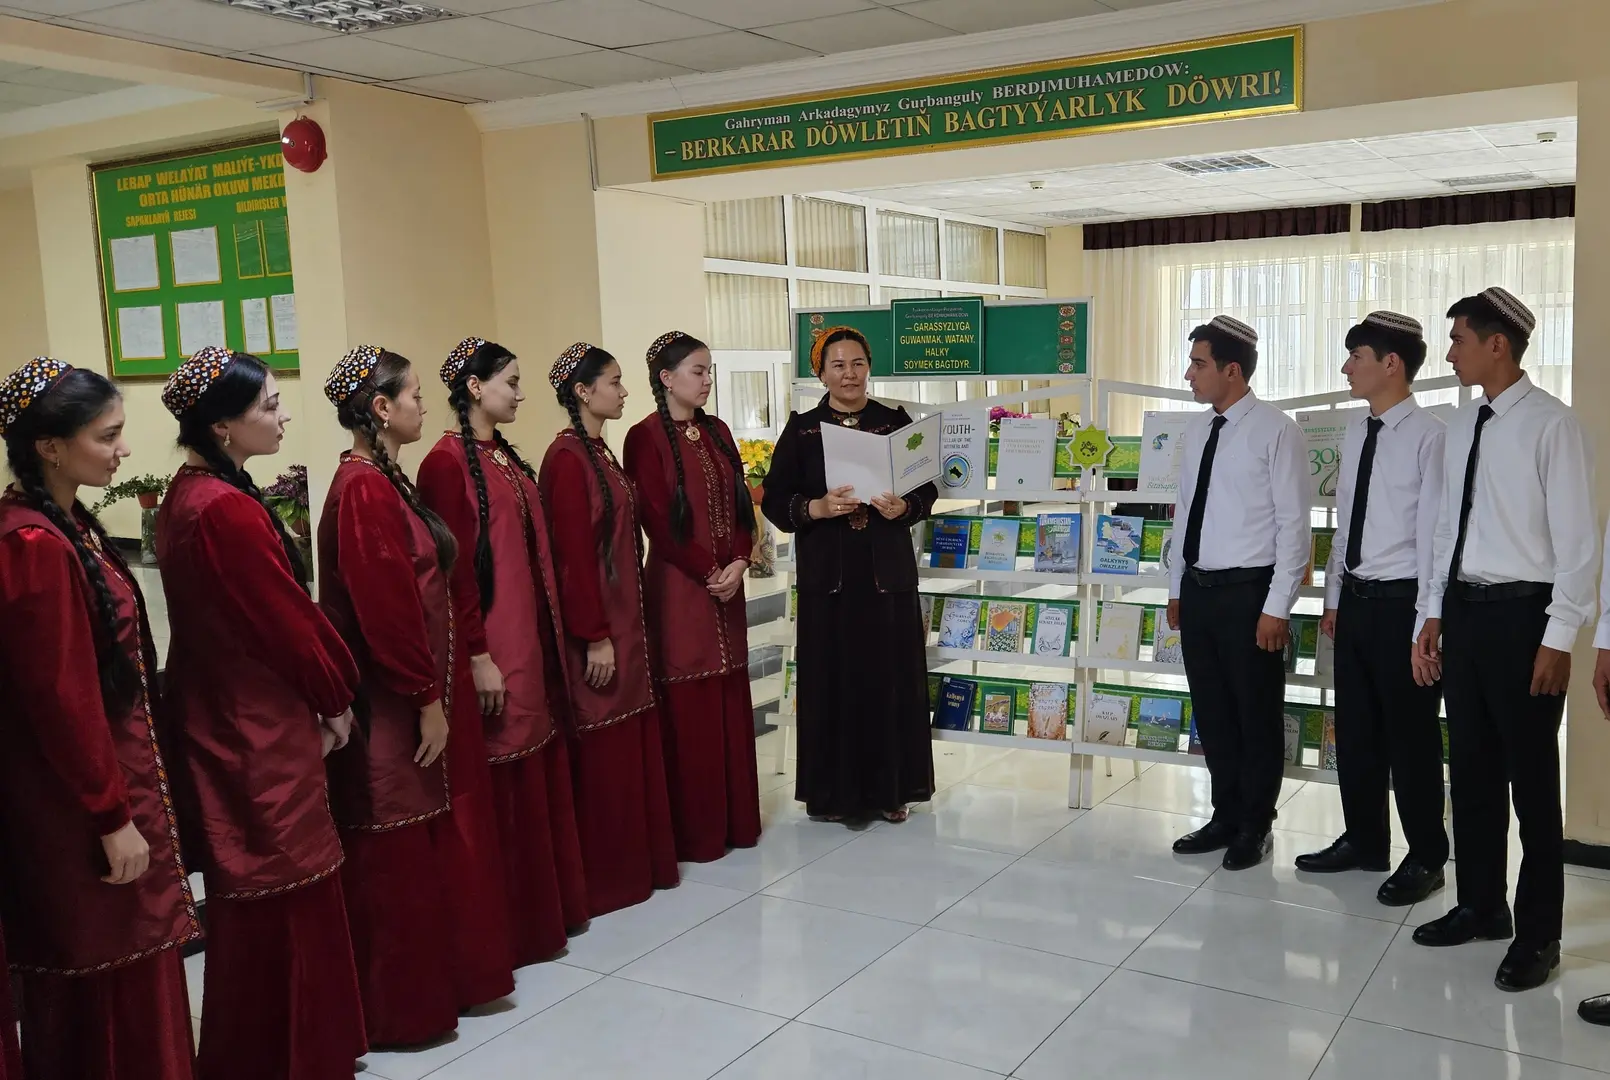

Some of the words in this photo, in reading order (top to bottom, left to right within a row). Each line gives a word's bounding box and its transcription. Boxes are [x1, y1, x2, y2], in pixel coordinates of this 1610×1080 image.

[725, 113, 791, 131] Gahryman
[798, 101, 890, 122] Arkadagymyz
[898, 89, 983, 110] Gurbanguly
[992, 62, 1190, 99] BERDIMUHAMEDOW:
[681, 129, 796, 161] BERKARAR
[806, 111, 933, 147] DÖWLETIŇ
[944, 87, 1147, 133] BAGTYÝARLYK
[1167, 69, 1282, 108] DÖWRI!
[117, 175, 151, 192] LEBAP
[139, 190, 169, 207] ORTA
[214, 178, 249, 196] OKUW
[925, 347, 950, 357] HALKY
